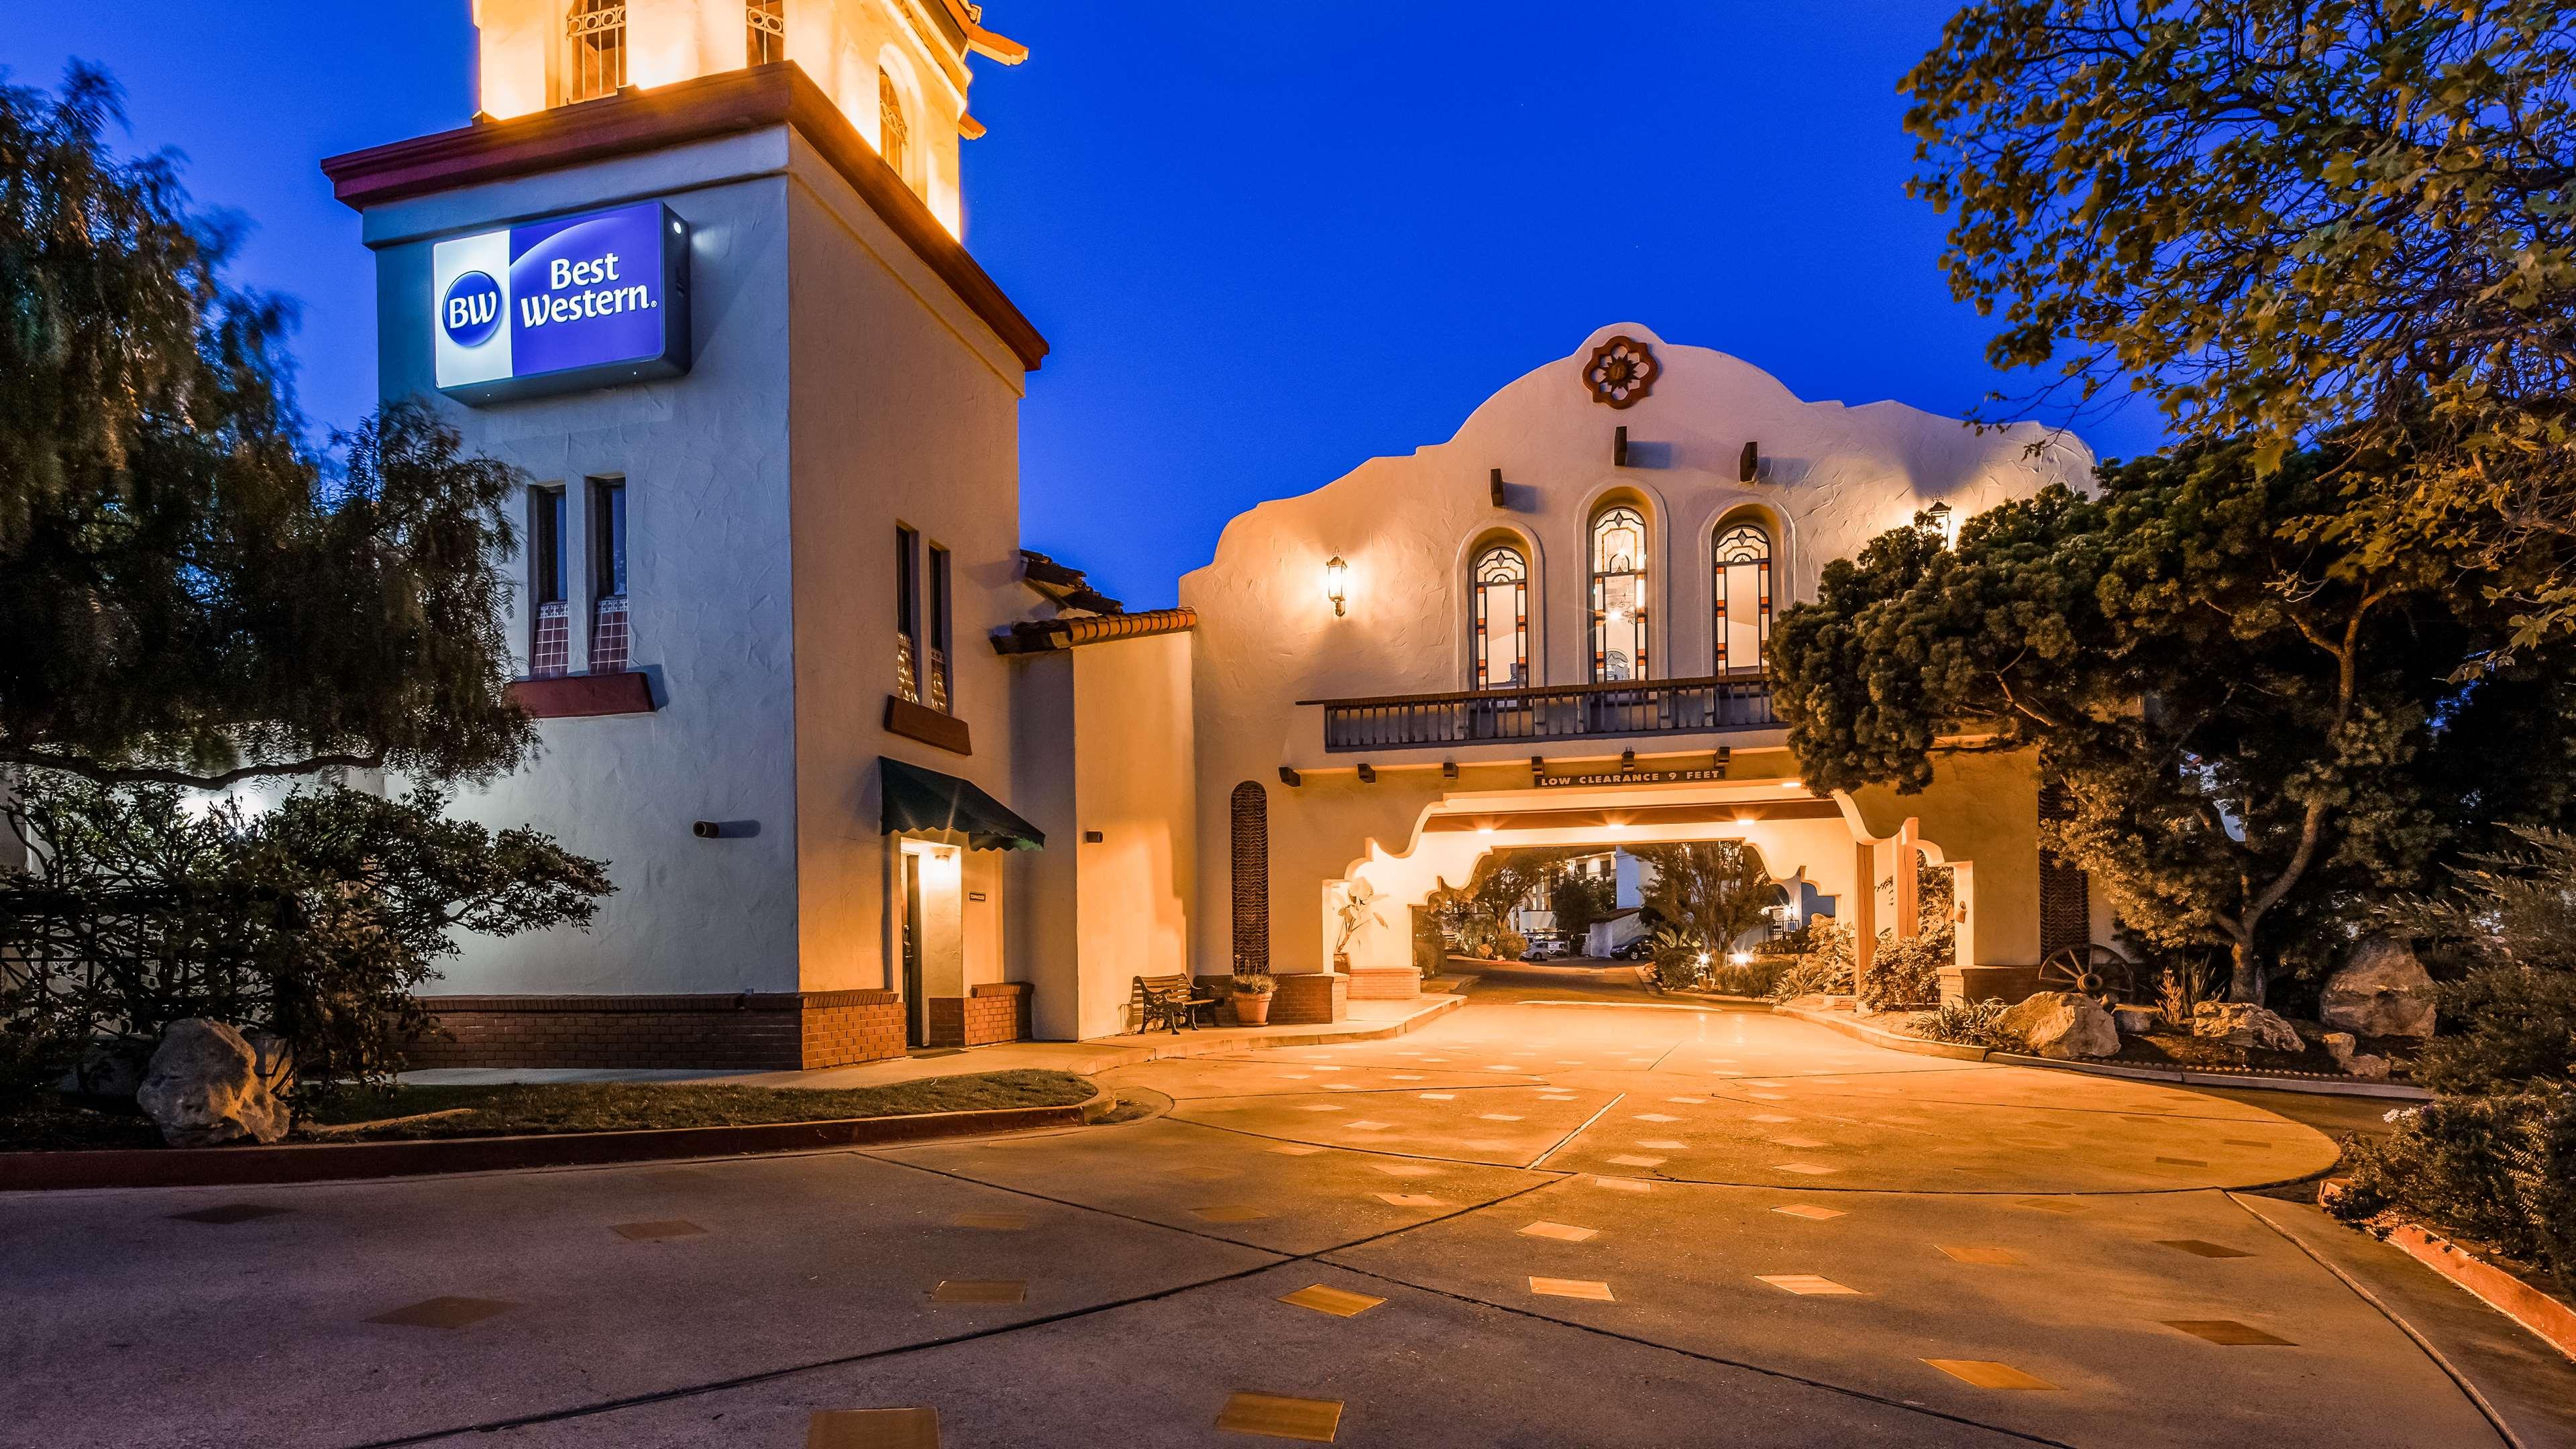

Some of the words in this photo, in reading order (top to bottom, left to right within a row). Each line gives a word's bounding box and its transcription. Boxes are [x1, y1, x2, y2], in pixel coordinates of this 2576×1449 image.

[550, 252, 620, 290] Best
[449, 291, 497, 329] BW
[1541, 777, 1571, 786] LOW
[1579, 773, 1659, 784] CLEARANCE
[1668, 772, 1677, 781] 9
[1686, 770, 1719, 780] FEET
